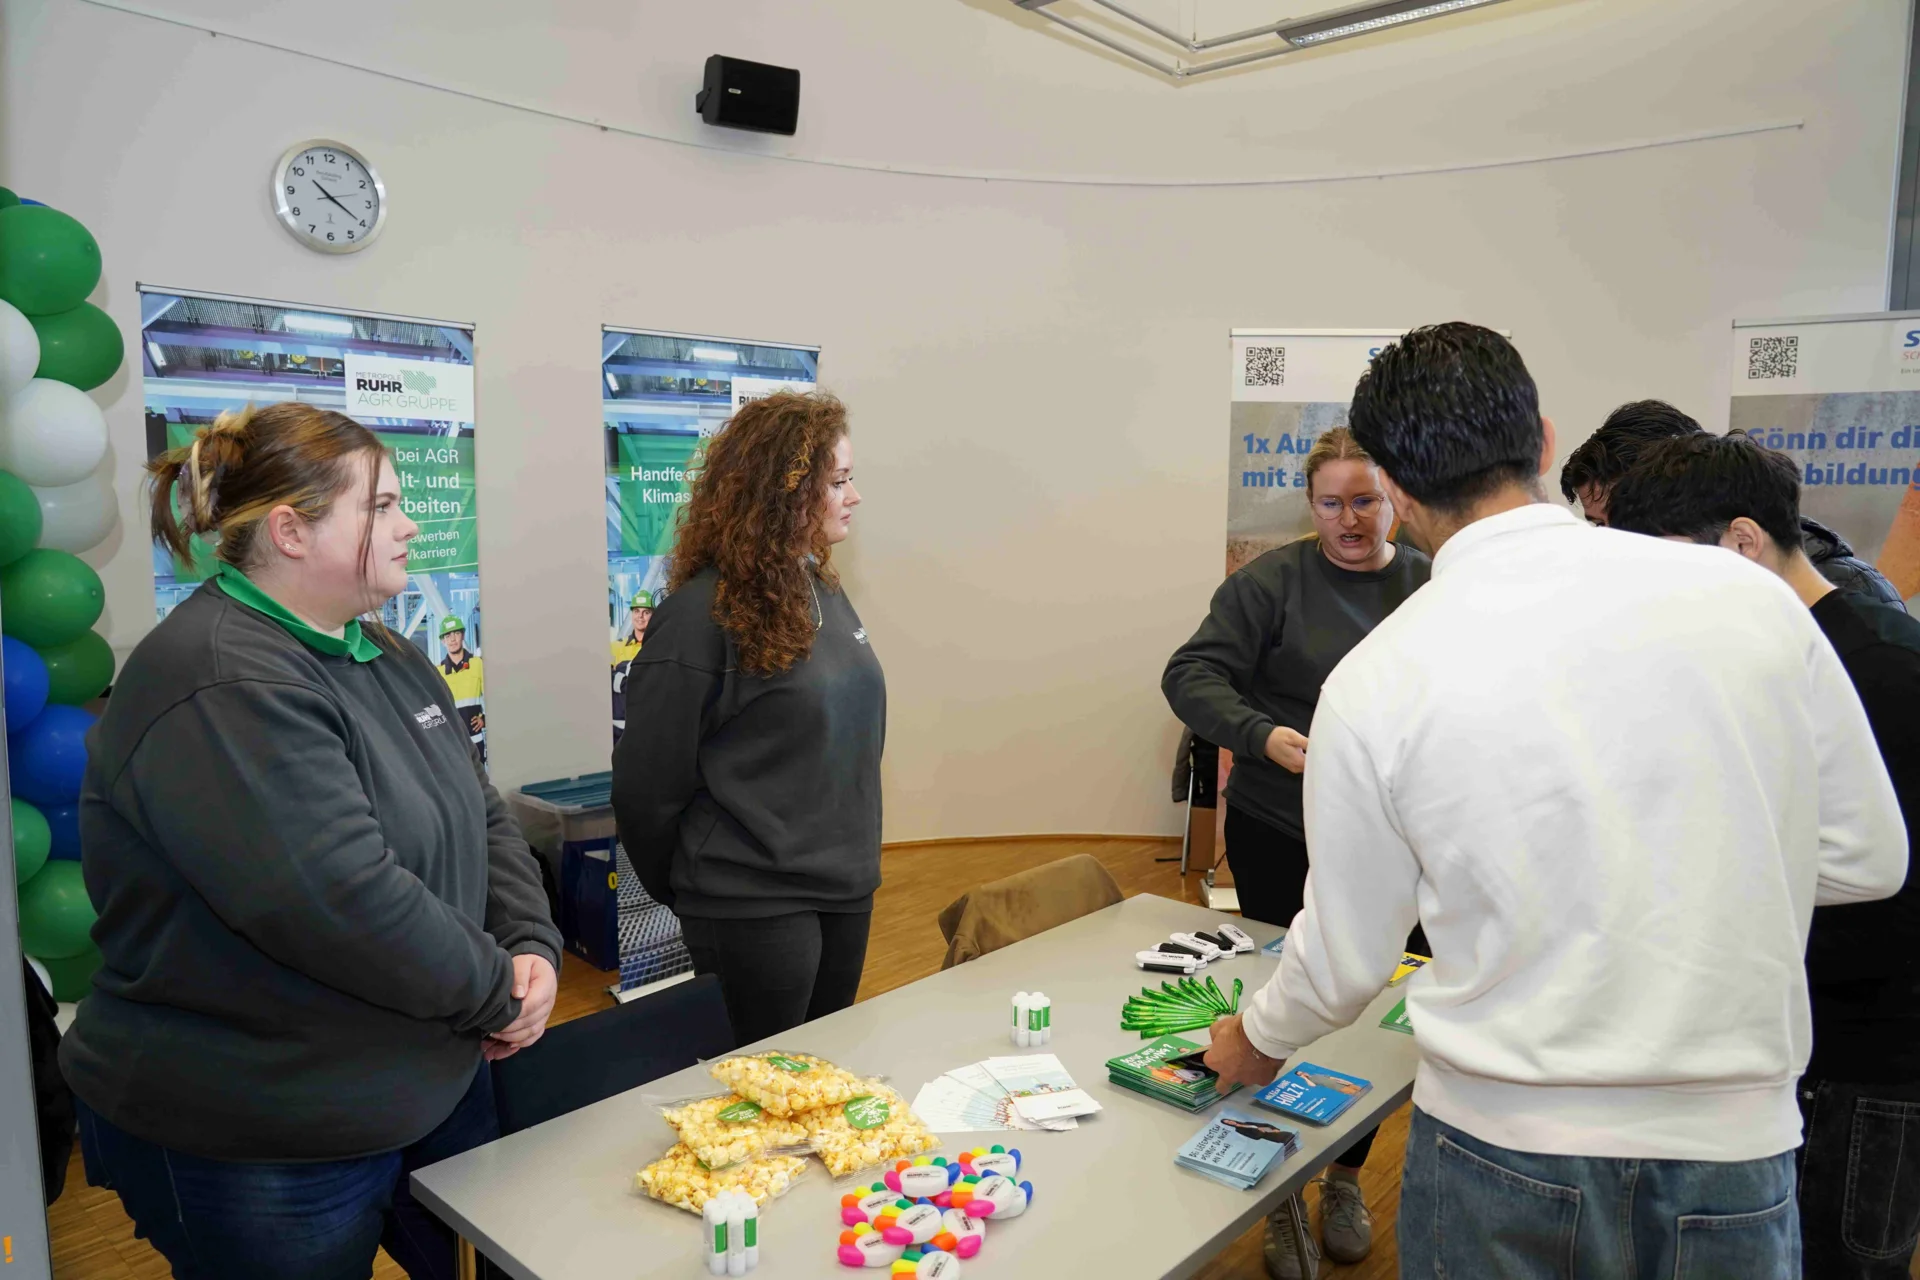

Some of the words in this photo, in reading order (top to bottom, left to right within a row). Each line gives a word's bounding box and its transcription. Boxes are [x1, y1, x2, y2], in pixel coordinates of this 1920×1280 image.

[305, 155, 315, 165] 11
[324, 153, 336, 164] 12
[292, 166, 305, 177] 10
[345, 162, 350, 171] 1
[359, 180, 367, 190] 2
[287, 186, 295, 195] 9
[365, 200, 372, 210] 3
[292, 207, 301, 217] 8
[359, 219, 367, 228] 4
[308, 224, 316, 234] 7
[326, 232, 335, 241] 6
[347, 230, 355, 240] 5
[356, 371, 401, 381] METROPOLE
[356, 378, 404, 393] RUHR
[357, 392, 393, 407] AGR
[396, 394, 458, 411] GRUPPE
[1243, 432, 1271, 454] 1x
[1275, 432, 1318, 454] Au
[1747, 427, 1827, 450] Gönn
[1835, 426, 1883, 449] dir
[395, 447, 419, 462] bei
[424, 448, 459, 464] AGR
[426, 472, 460, 489] und
[1242, 466, 1287, 489] mit
[406, 546, 457, 560] /karriere
[1273, 1082, 1310, 1106] HOLZ?
